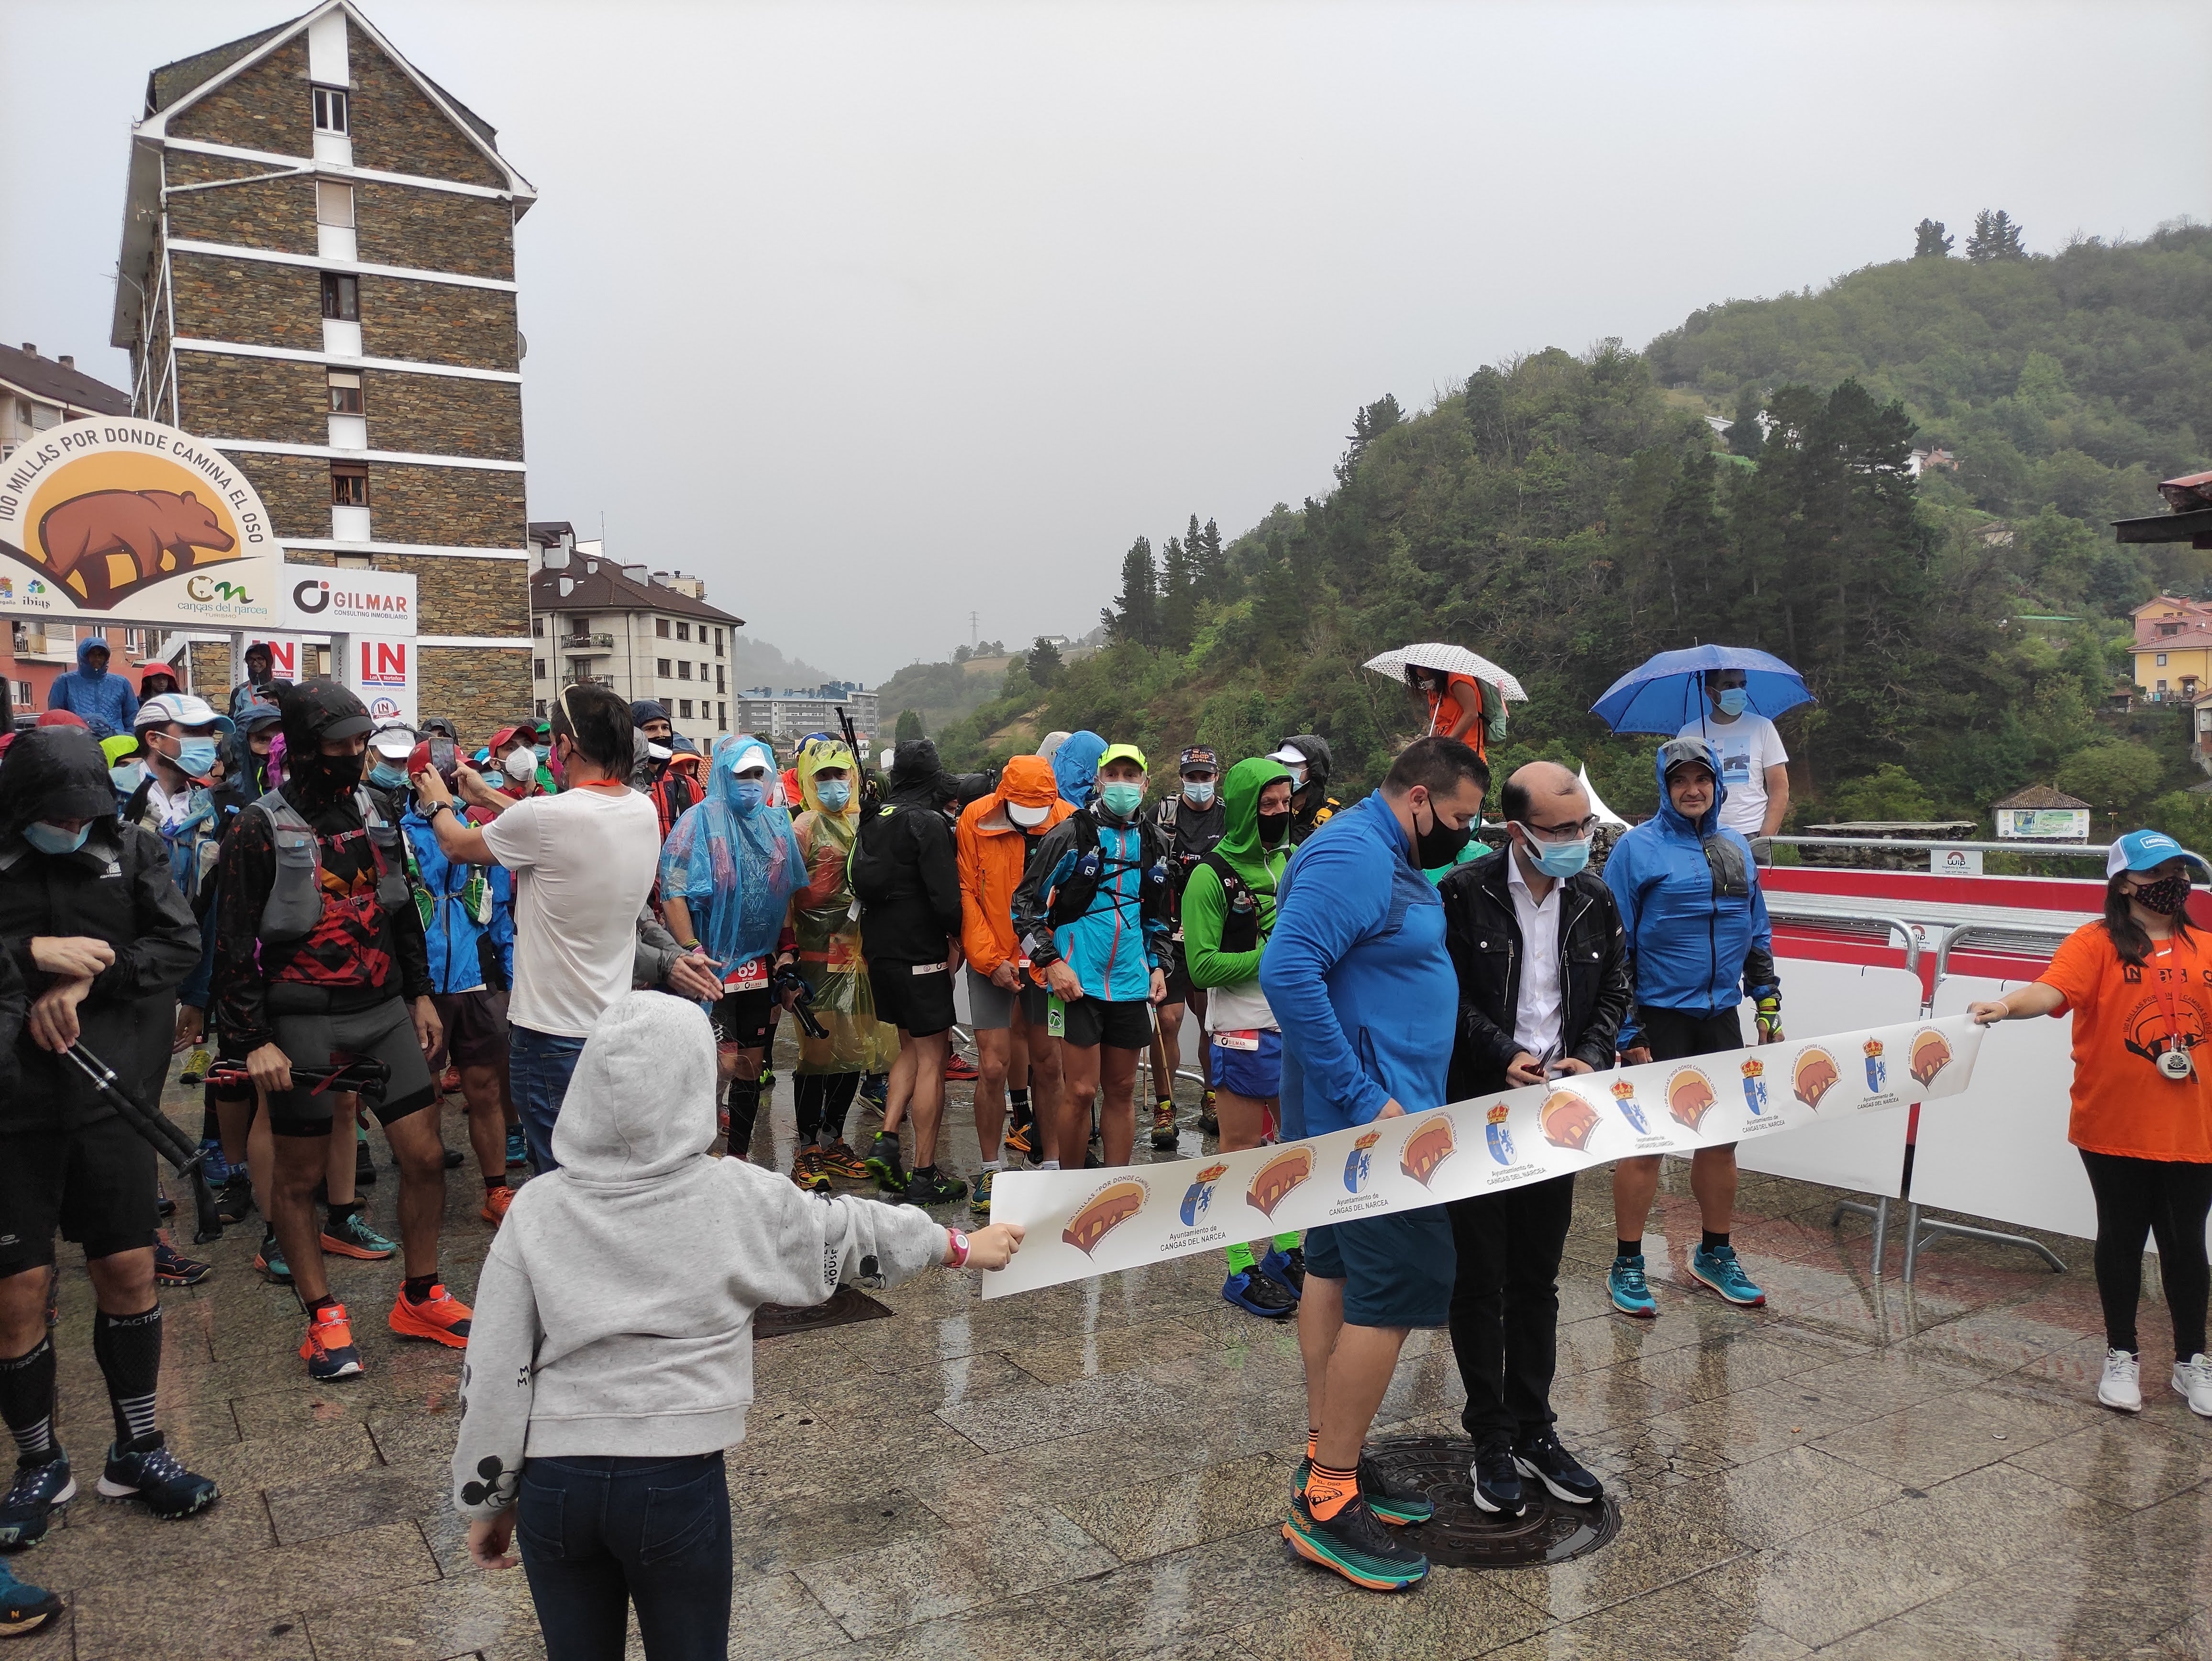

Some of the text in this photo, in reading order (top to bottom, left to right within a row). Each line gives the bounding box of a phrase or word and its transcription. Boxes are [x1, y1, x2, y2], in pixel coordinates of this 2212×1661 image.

[0, 428, 264, 543] 100 MILLAS POR DONDE CAMINA EL OSO
[23, 597, 50, 609] ibias
[216, 603, 231, 611] del
[235, 606, 267, 615] narcea
[334, 592, 407, 612] GILMAR
[362, 642, 405, 680] LN
[737, 960, 757, 977] 69
[2126, 1003, 2144, 1023] MILLAS
[2143, 995, 2158, 1004] POR
[2183, 995, 2204, 1013] CAMINA
[1693, 1065, 1707, 1078] CAMINA
[1863, 1094, 1888, 1103] Ayuntamiento
[1747, 1116, 1772, 1125] Ayuntamiento
[1075, 1193, 1095, 1215] MILLAS
[1113, 1175, 1134, 1184] DONDE
[1337, 1194, 1371, 1206] Ayuntamiento
[1329, 1206, 1352, 1216] CANGAS
[1366, 1199, 1389, 1209] NARCEA
[1160, 1232, 1226, 1251] CANGAS DEL NARCEA
[1170, 1227, 1208, 1241] Ayuntamiento
[828, 1249, 839, 1285] MOUSE
